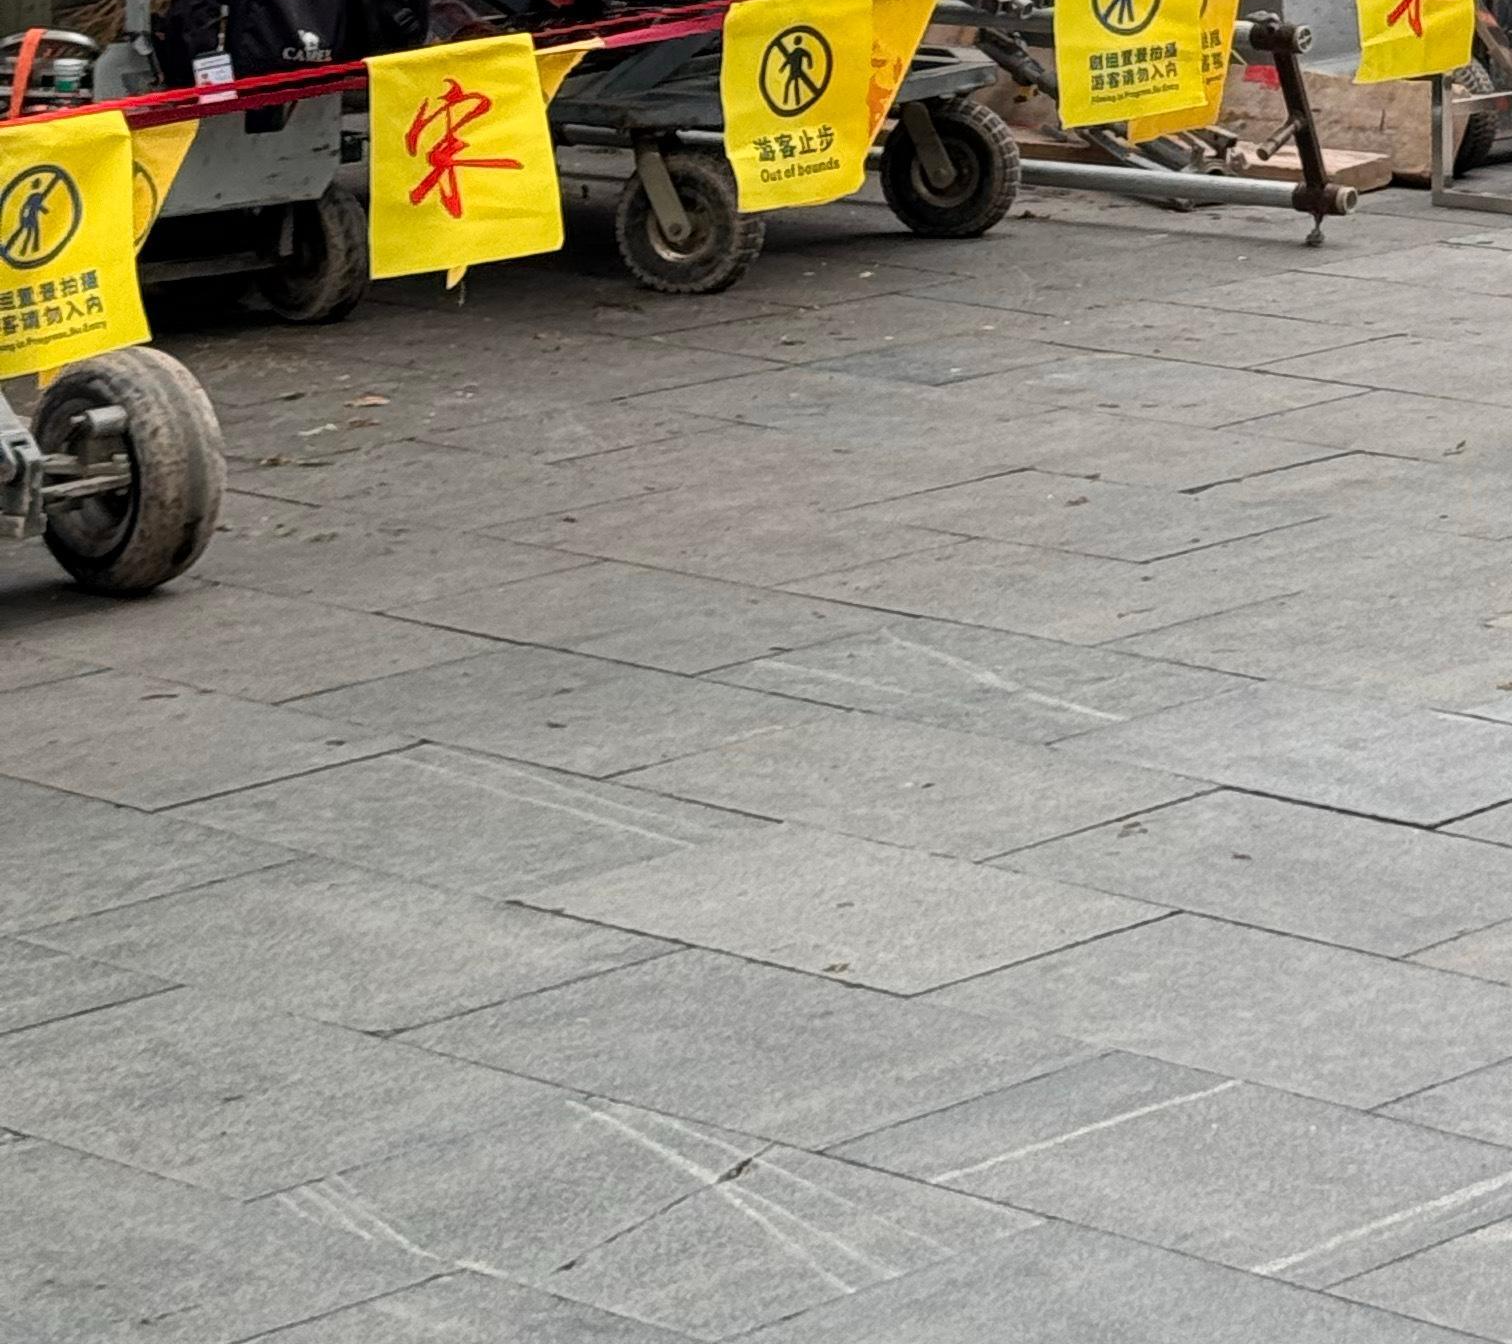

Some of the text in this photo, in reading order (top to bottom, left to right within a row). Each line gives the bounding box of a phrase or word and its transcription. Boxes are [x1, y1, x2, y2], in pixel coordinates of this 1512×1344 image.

[752, 123, 835, 162] 游客止步
[760, 156, 840, 183] Out of bounds
